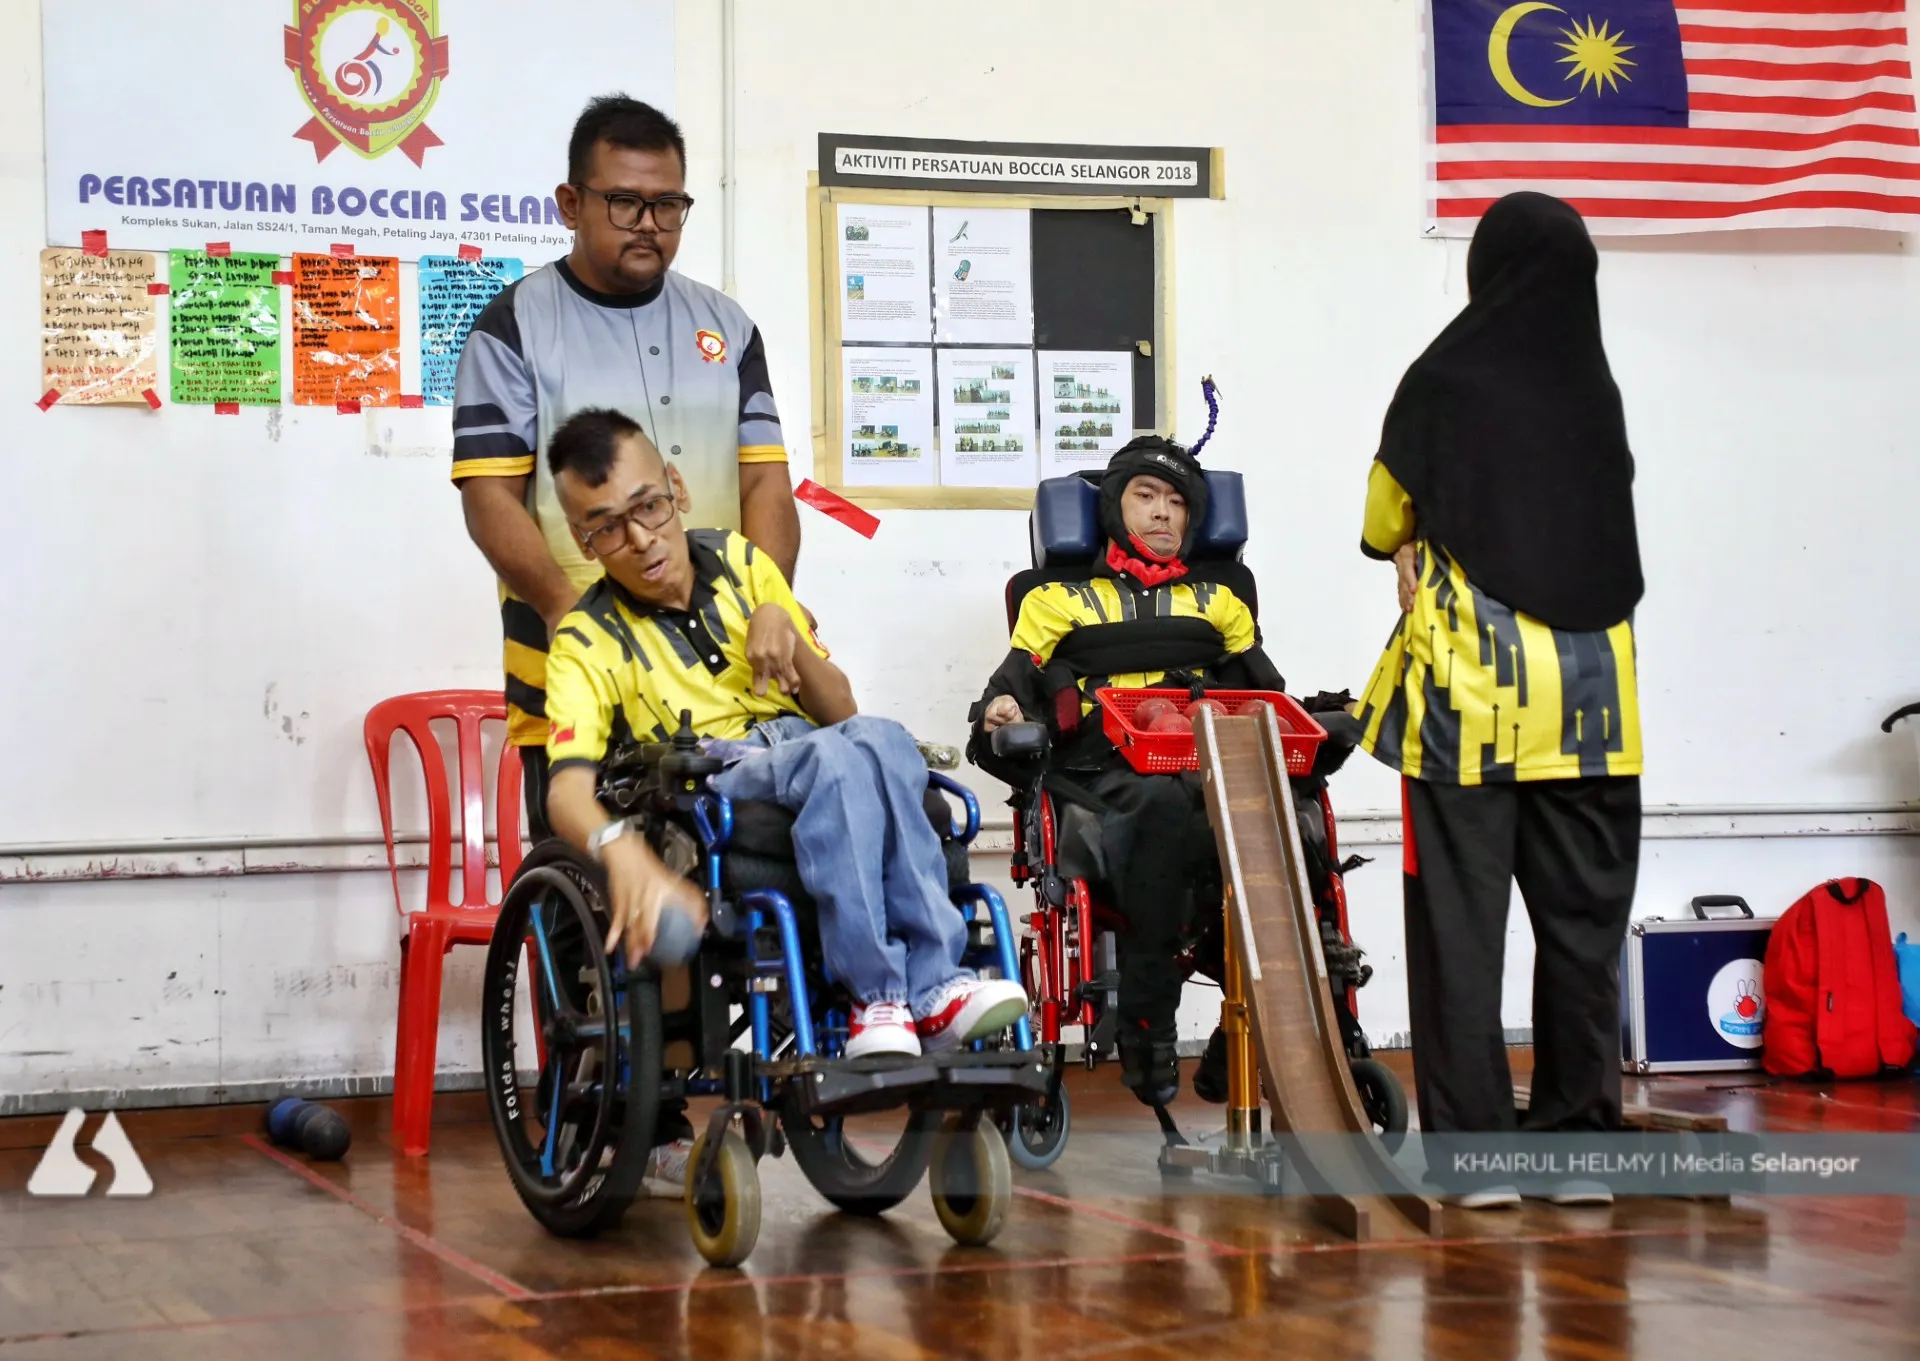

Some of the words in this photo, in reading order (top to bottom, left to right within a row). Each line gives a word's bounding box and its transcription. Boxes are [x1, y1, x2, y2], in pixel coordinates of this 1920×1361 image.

[841, 153, 907, 171] AKTIVITI
[911, 158, 1003, 176] PERSATUAN
[1008, 163, 1066, 177] BOCCIA
[1070, 164, 1150, 180] SELANGOR
[1156, 166, 1193, 181] 2018
[79, 173, 296, 214] PERSATUAN
[312, 185, 447, 221] BOCCIA
[121, 215, 178, 228] Kompleks
[182, 218, 221, 230] Sukan,
[224, 220, 253, 231] Jalan
[256, 222, 298, 234] SS24/1,
[301, 223, 337, 235] Taman
[341, 225, 380, 239] Megah,
[383, 228, 426, 241] Petaling
[429, 230, 458, 241] Jaya,
[460, 231, 491, 241] 47301
[494, 232, 537, 246] Petaling
[540, 235, 568, 246] Jaya,
